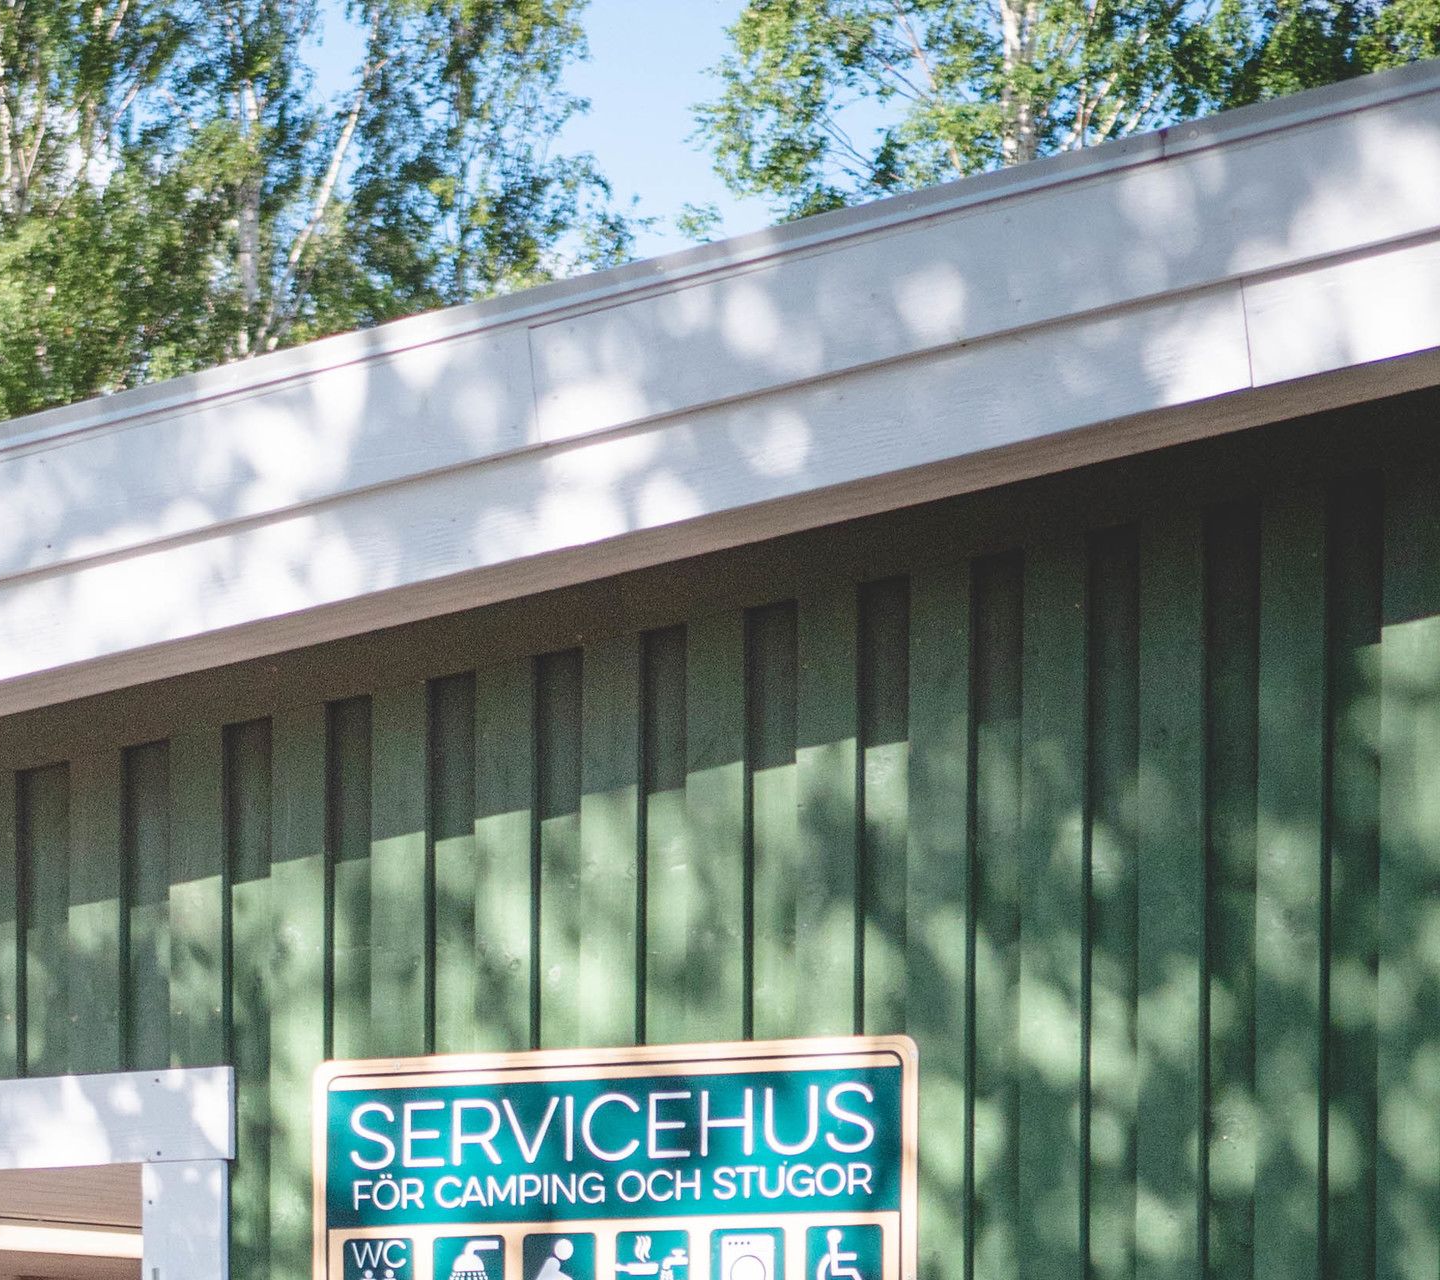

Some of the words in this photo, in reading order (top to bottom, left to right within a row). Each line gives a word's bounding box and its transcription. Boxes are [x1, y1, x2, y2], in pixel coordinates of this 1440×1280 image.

[350, 1082, 875, 1170] SERVICEHUS
[353, 1173, 425, 1211] FÖR
[434, 1172, 606, 1209] CAMPING
[616, 1168, 701, 1203] OCH
[713, 1162, 873, 1200] STUGOR
[351, 1239, 407, 1269] WC
